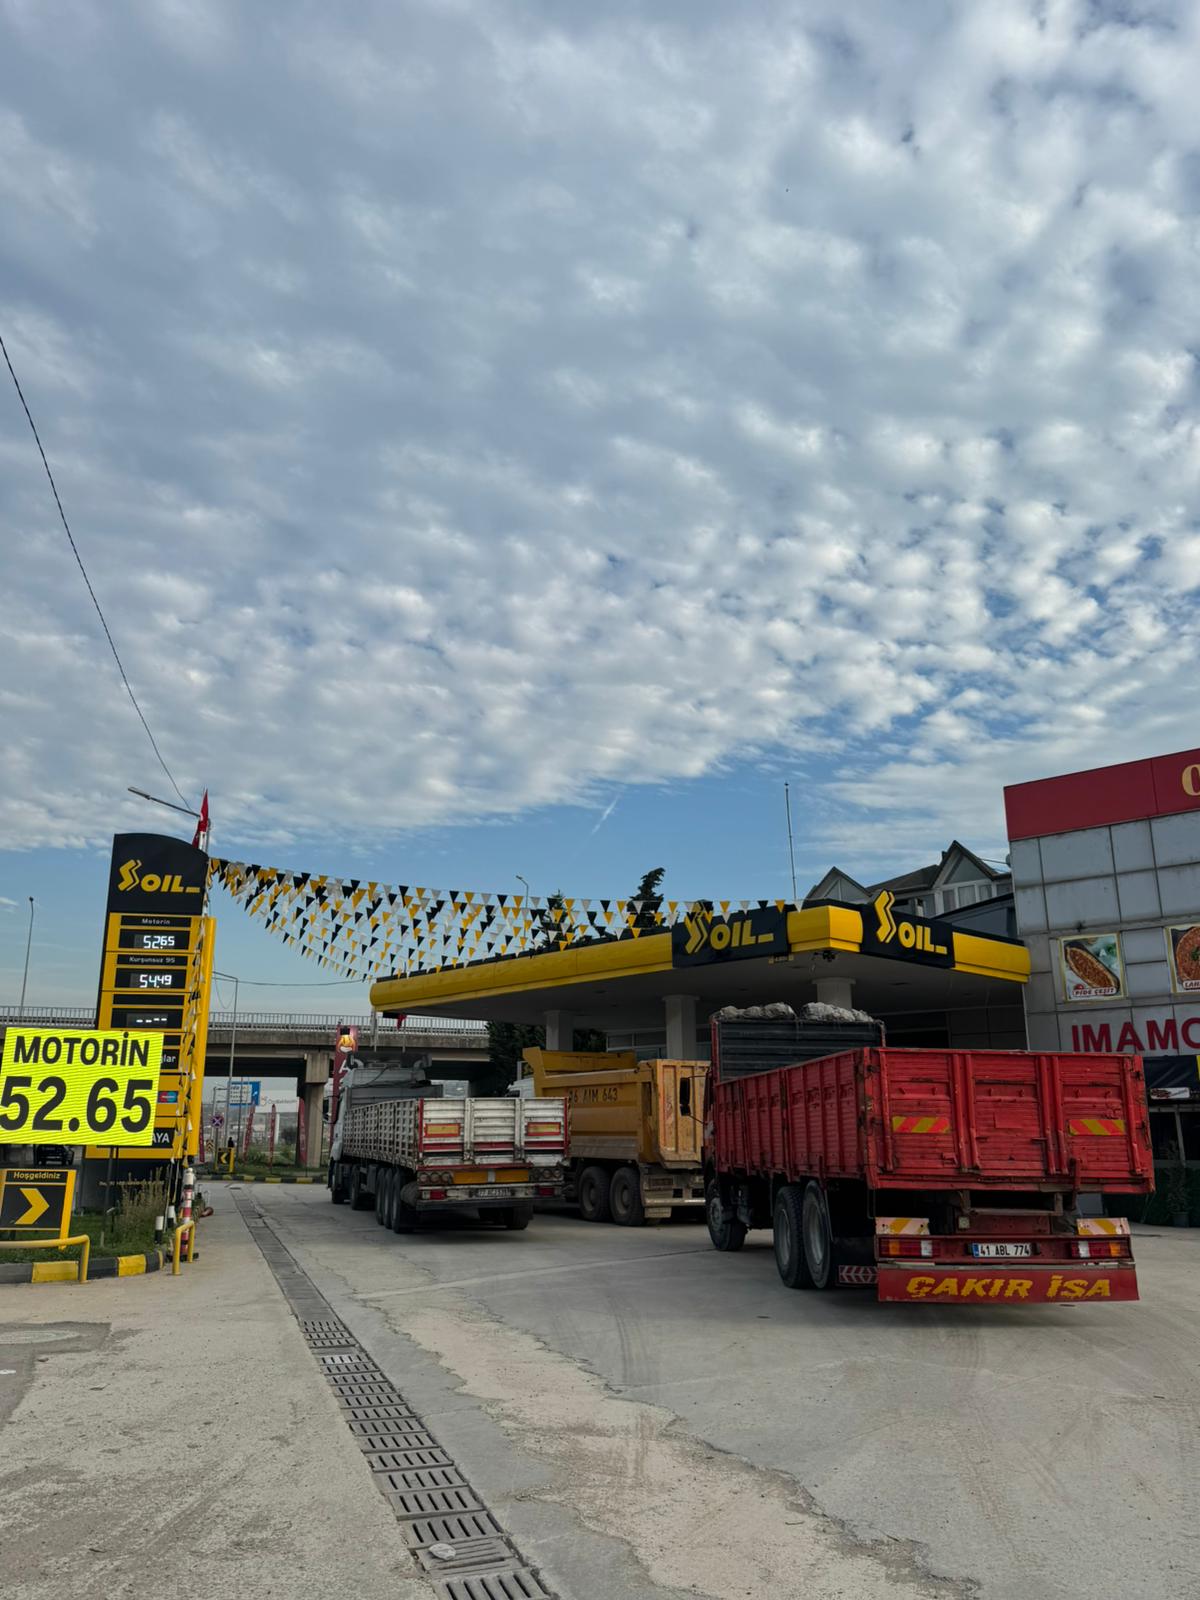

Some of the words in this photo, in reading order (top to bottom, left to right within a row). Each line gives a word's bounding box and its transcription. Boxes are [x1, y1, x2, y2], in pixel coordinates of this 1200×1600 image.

[142, 917, 170, 925] Motorin
[143, 935, 175, 949] 52.65
[139, 974, 172, 988] 54.49
[13, 1032, 149, 1067] MOTORİN
[0, 1076, 153, 1132] 52.65
[13, 1171, 61, 1180] Hoşgeldiniz
[980, 1244, 990, 1256] 41
[995, 1244, 1010, 1256] ABL
[1013, 1244, 1030, 1256] 774
[906, 1276, 1033, 1299] ÇAKIR
[1046, 1275, 1111, 1298] İSA
